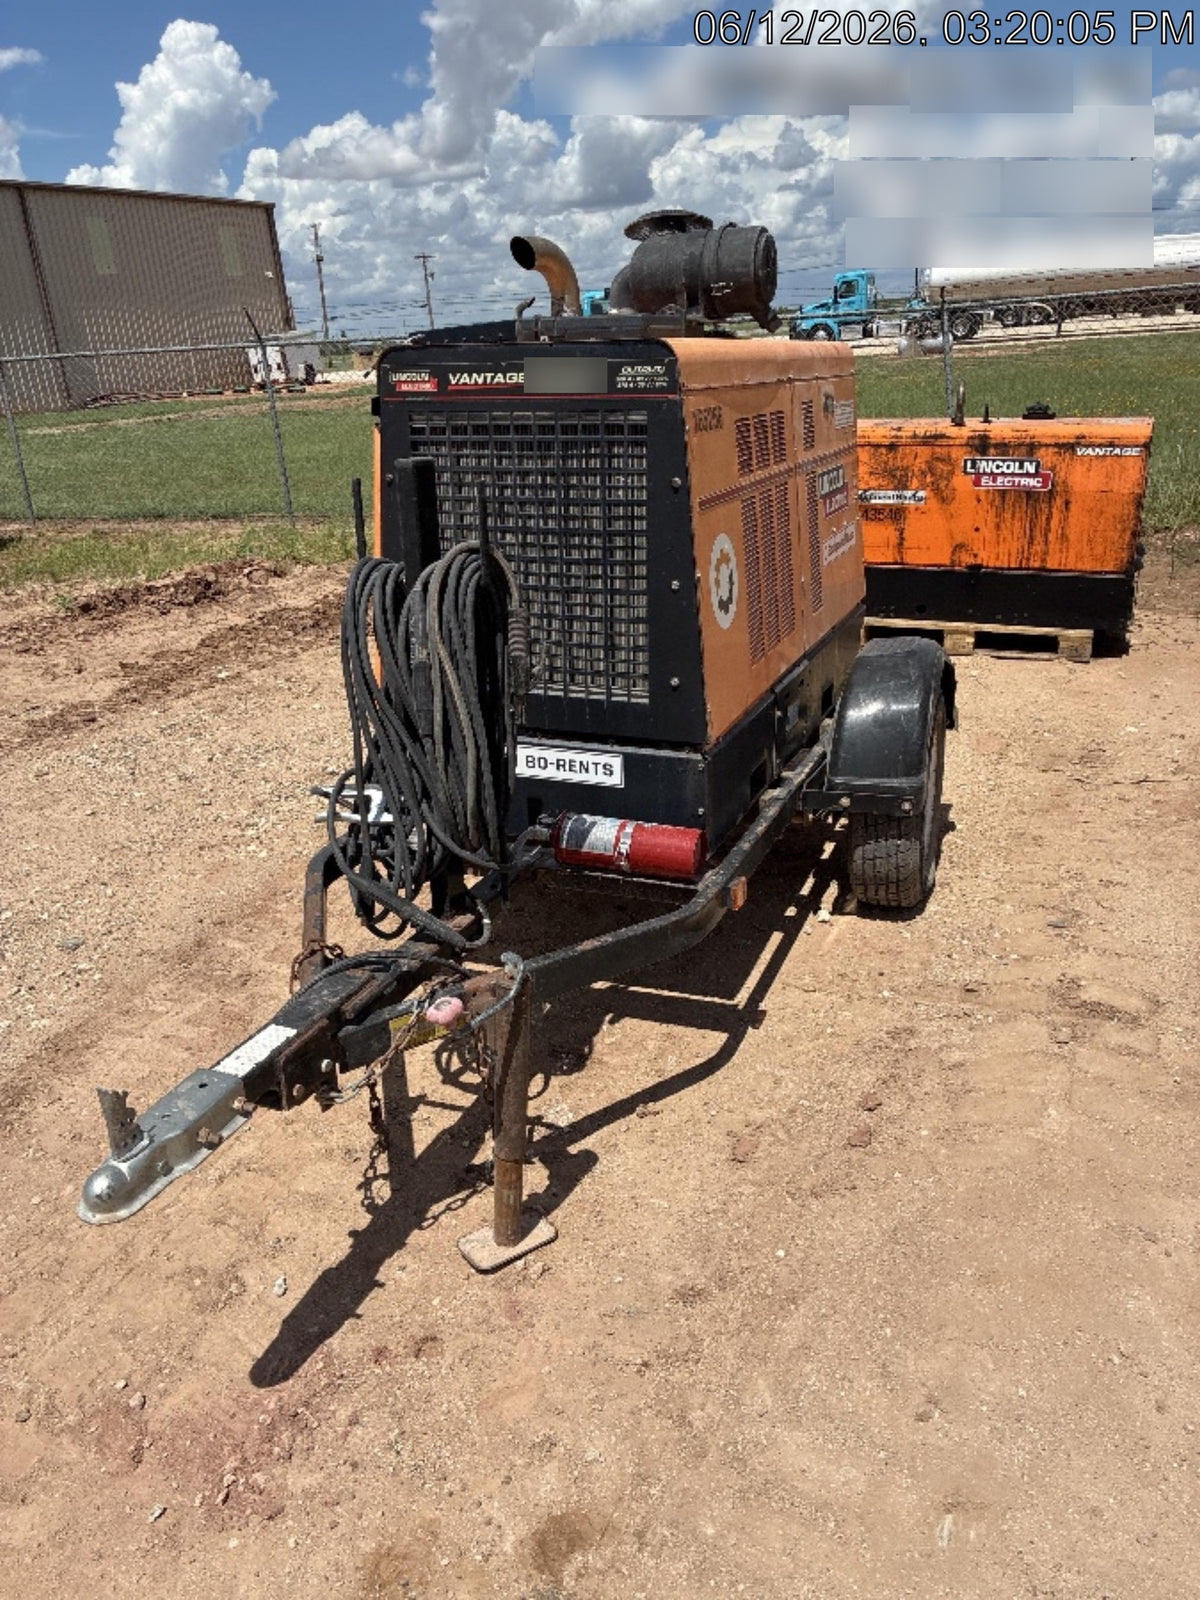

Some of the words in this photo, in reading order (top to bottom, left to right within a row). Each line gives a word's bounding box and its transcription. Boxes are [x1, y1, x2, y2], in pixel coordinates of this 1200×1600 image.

[1076, 447, 1142, 456] VANTAGE
[966, 461, 1037, 474] LINCOLN
[981, 478, 1043, 487] ELECTRIC
